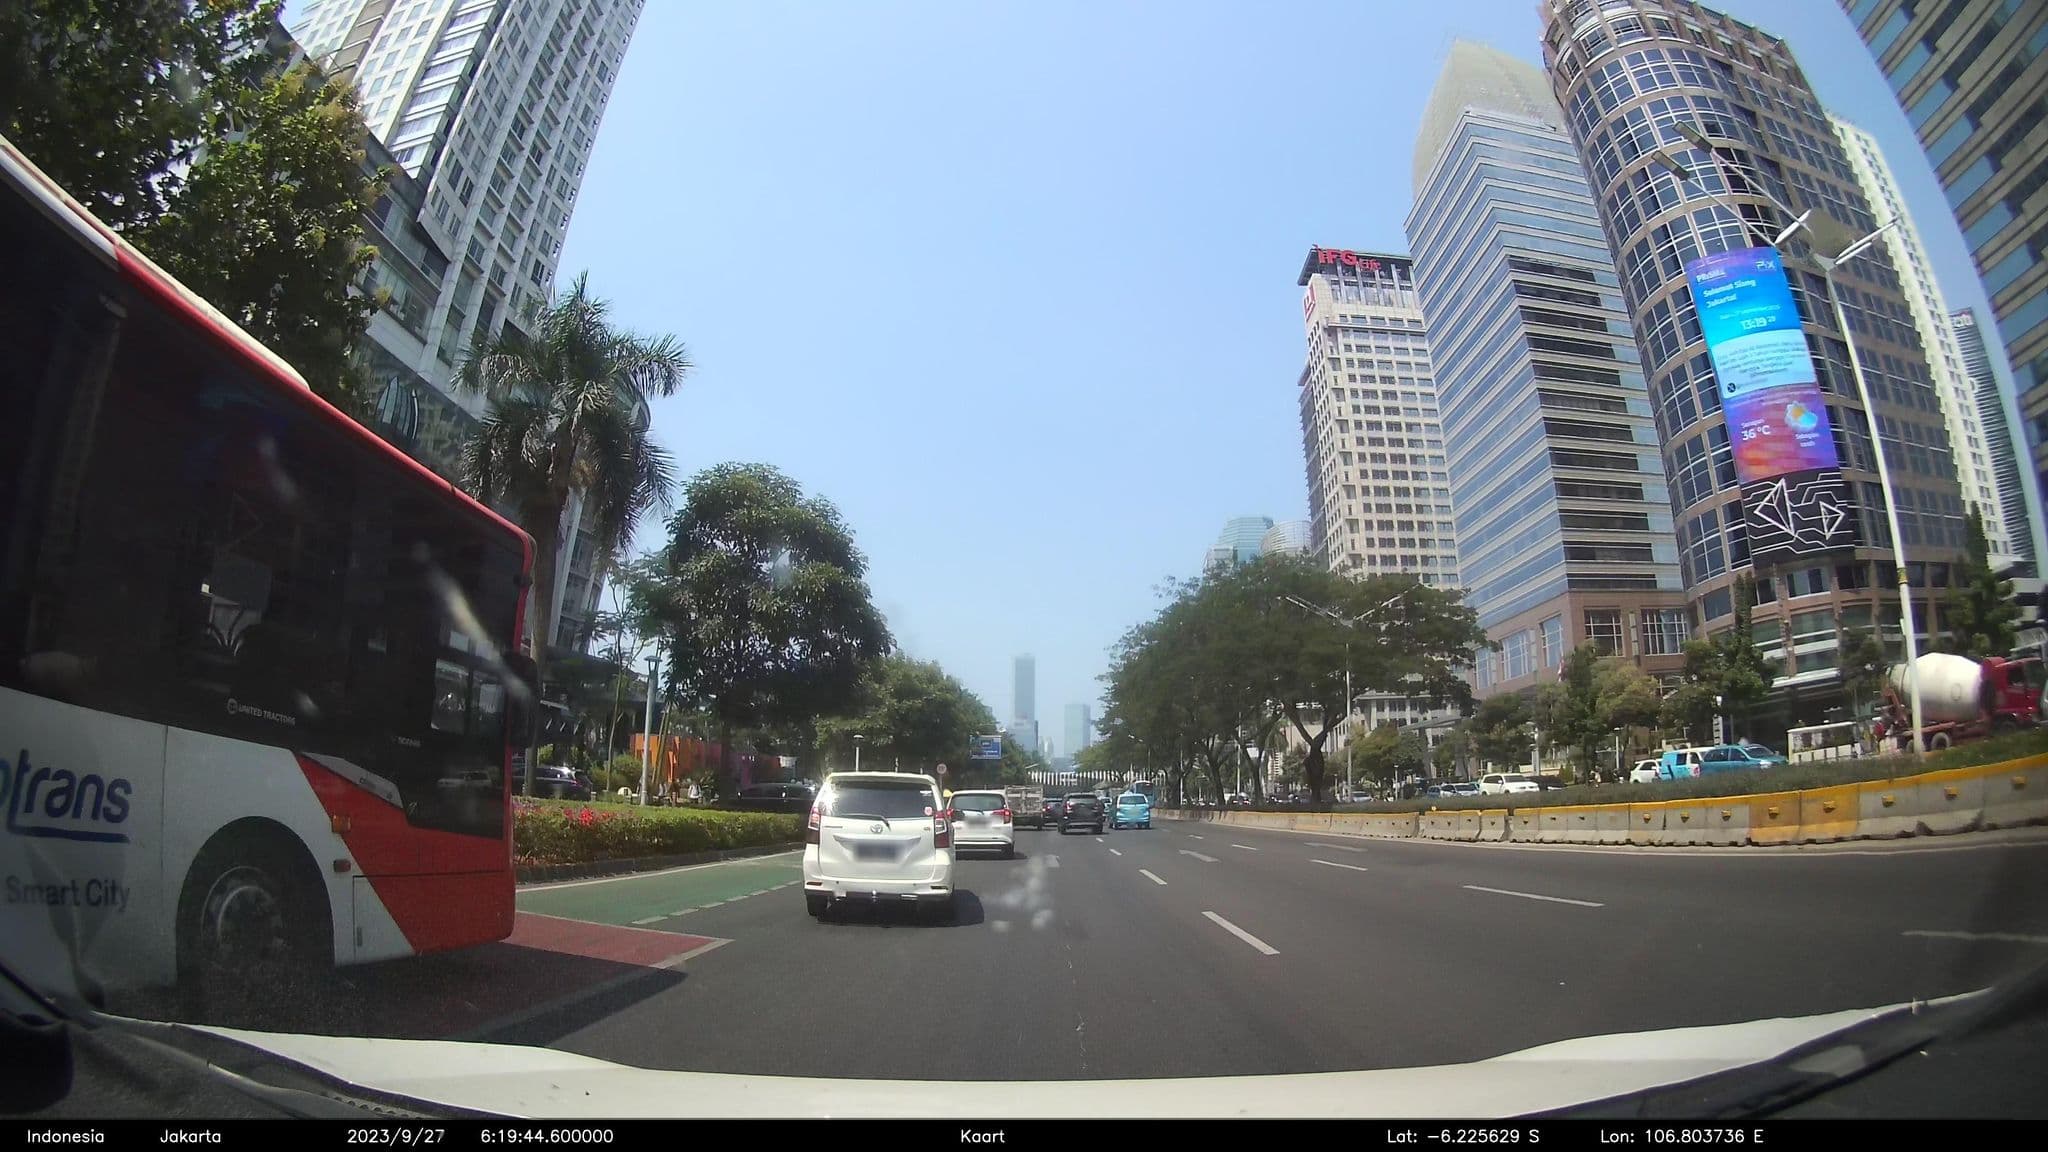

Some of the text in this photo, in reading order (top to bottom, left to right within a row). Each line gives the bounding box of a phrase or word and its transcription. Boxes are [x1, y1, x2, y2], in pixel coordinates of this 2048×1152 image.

[1312, 244, 1357, 266] IFG
[6, 875, 131, 913] Smart City
